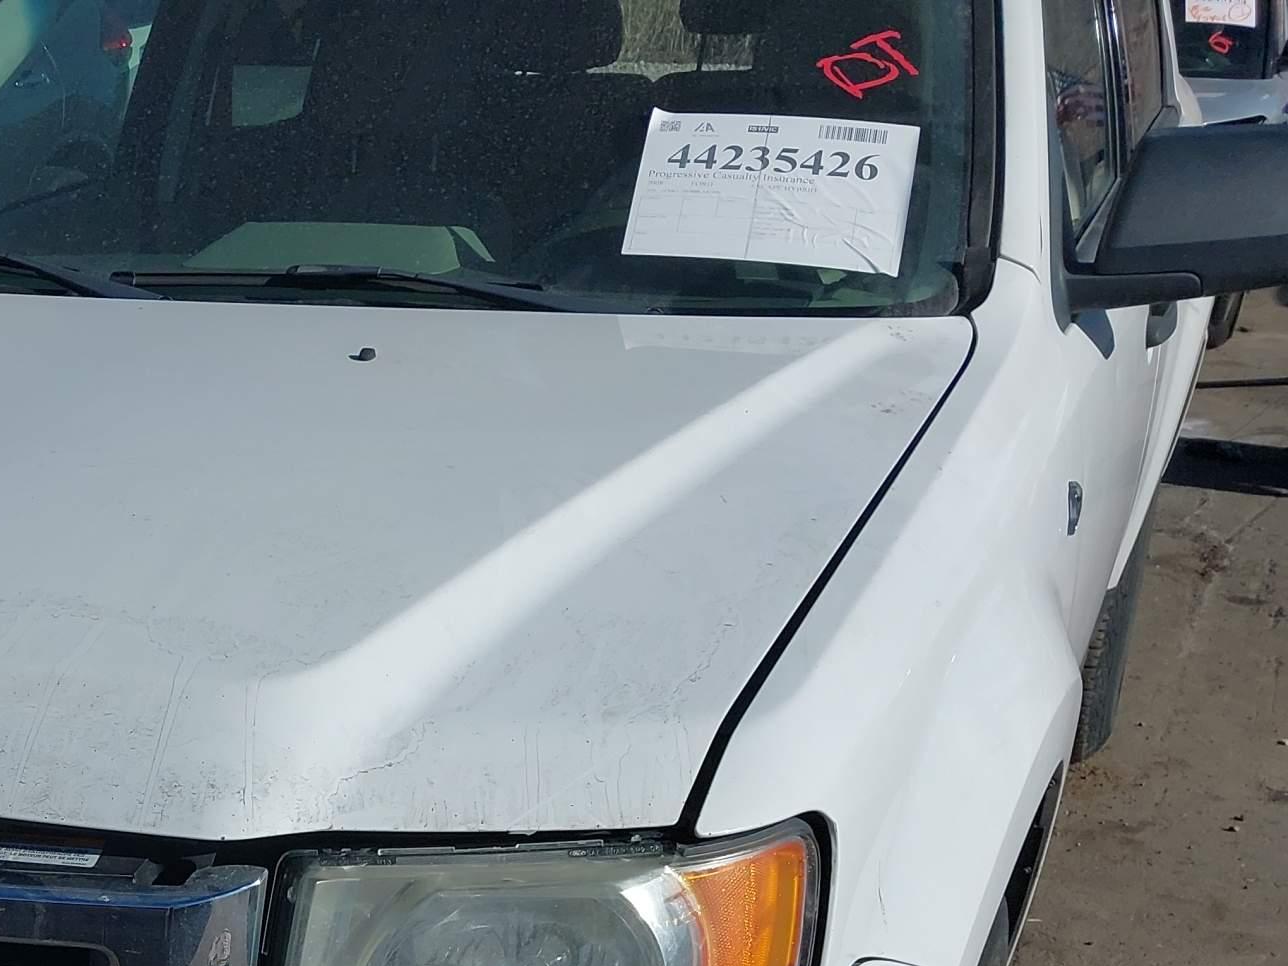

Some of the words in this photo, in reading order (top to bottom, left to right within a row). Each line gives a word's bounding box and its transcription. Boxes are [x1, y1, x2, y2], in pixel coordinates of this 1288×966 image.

[667, 143, 881, 181] 44235426
[648, 169, 710, 180] Progressive
[713, 171, 759, 182] Casualty
[763, 173, 816, 185] Insurance
